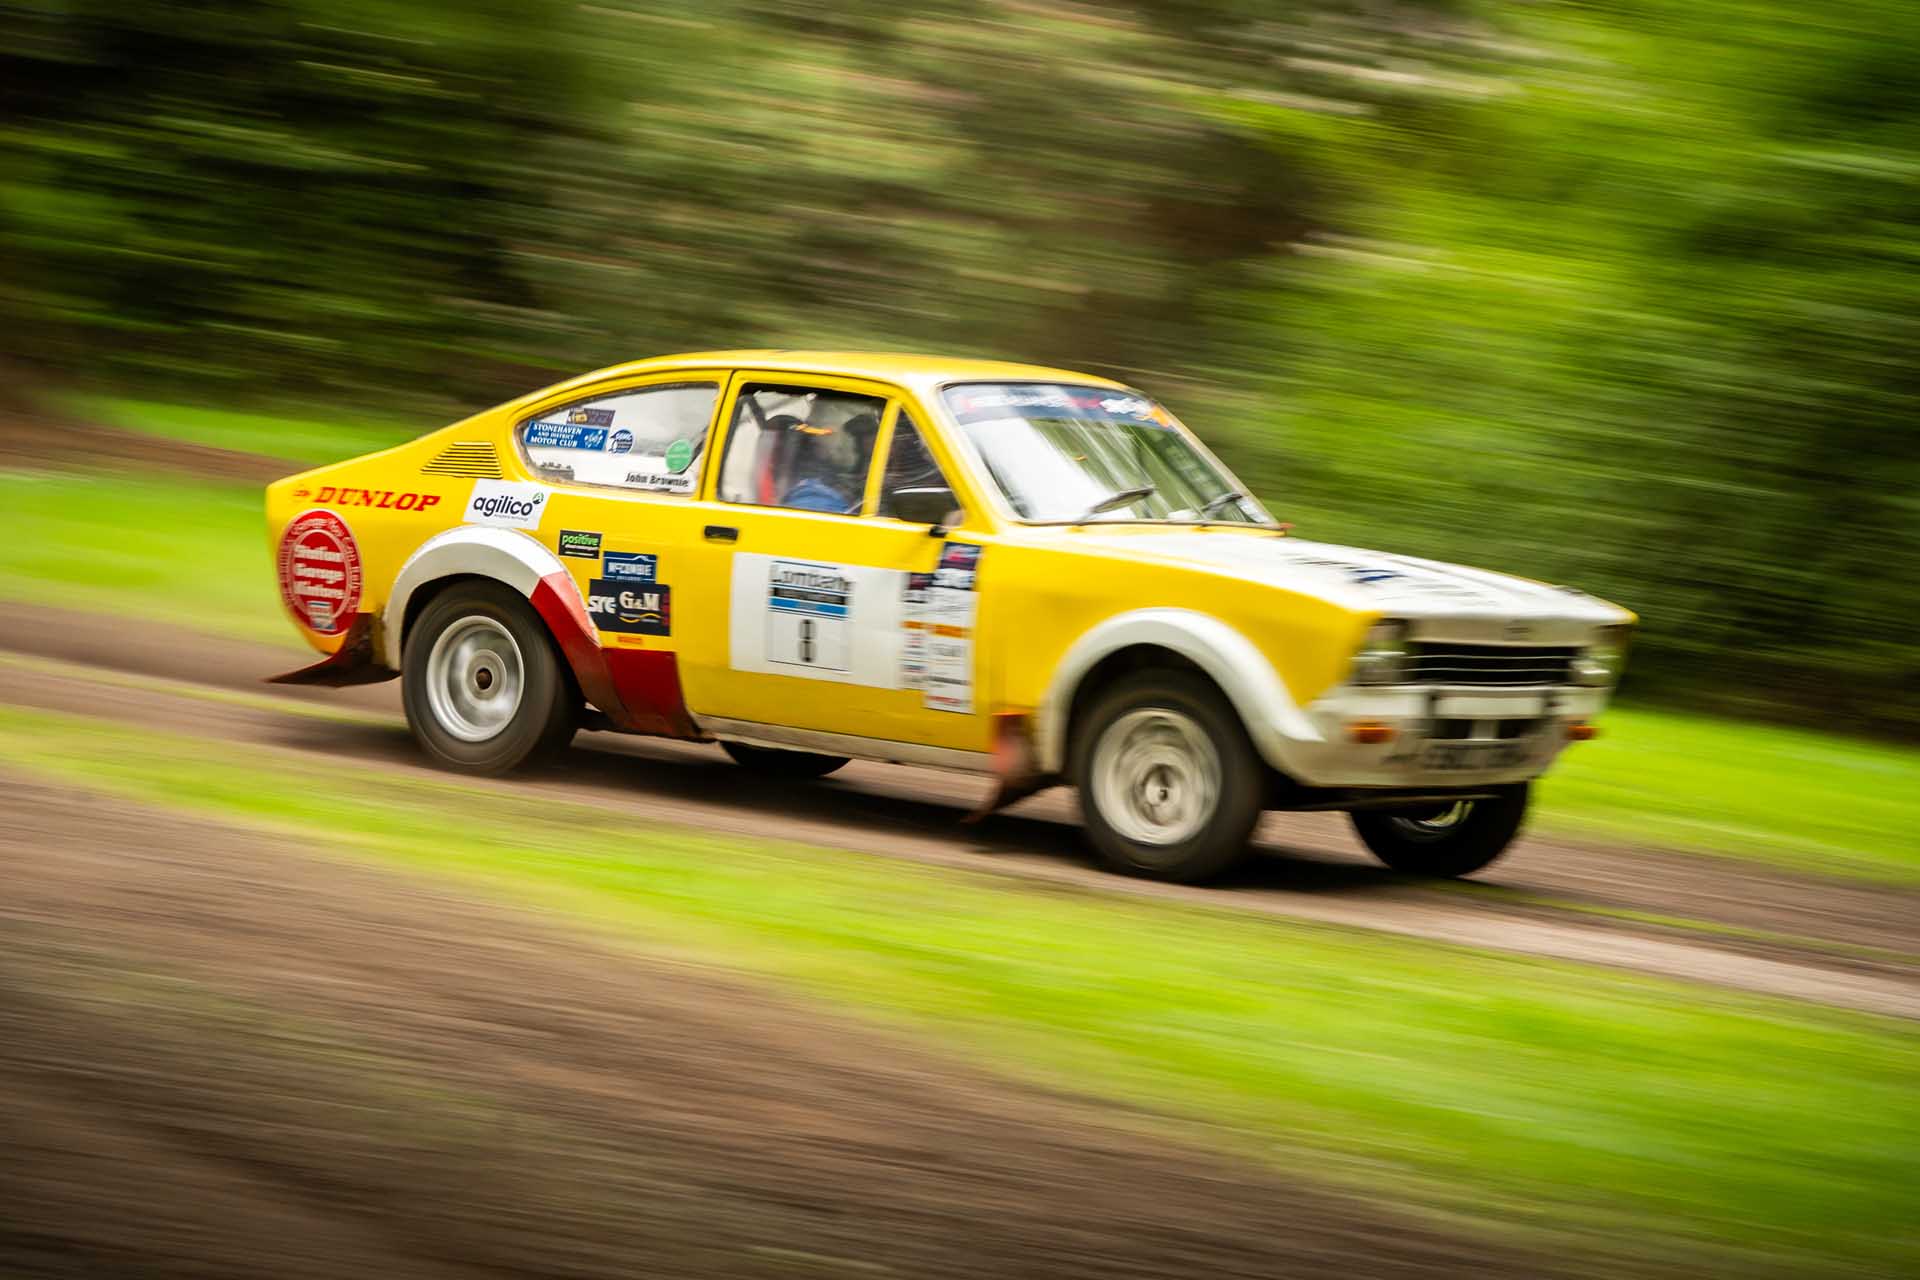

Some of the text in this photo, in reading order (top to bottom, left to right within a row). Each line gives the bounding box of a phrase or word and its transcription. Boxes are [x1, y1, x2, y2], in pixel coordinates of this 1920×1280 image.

[533, 423, 583, 435] STONEHAVEN
[530, 436, 578, 447] MOTOR CLUB
[313, 486, 441, 512] DUNLOP
[473, 495, 533, 517] agilico
[561, 533, 599, 546] positive
